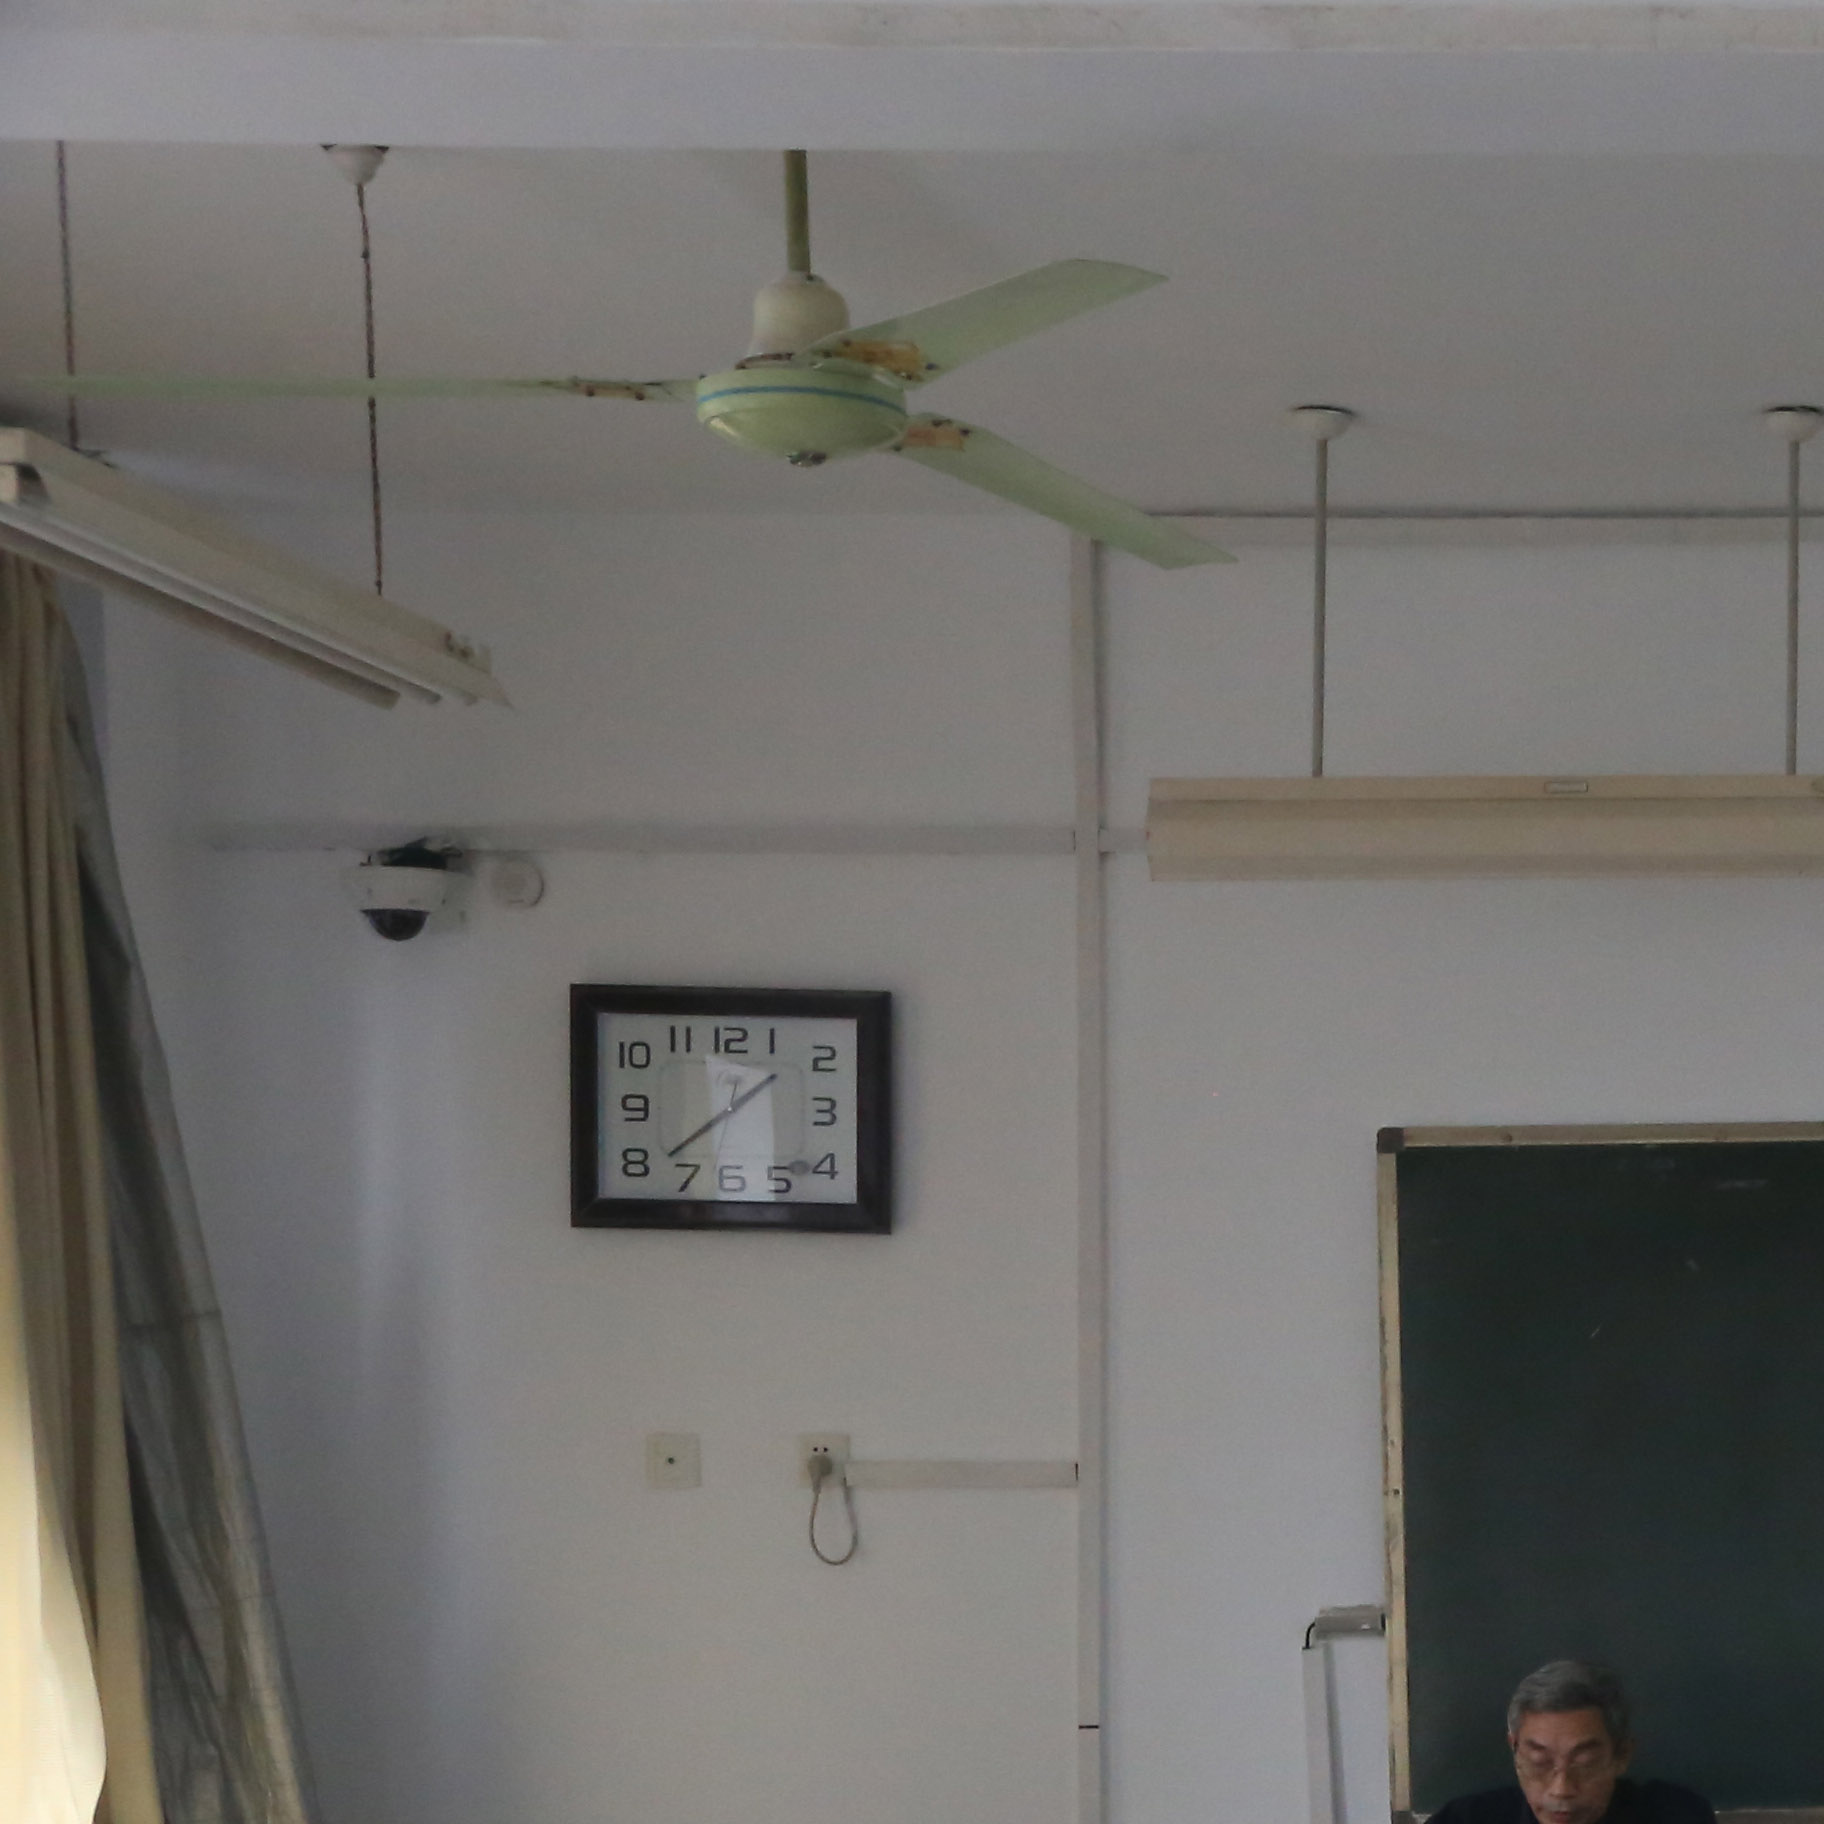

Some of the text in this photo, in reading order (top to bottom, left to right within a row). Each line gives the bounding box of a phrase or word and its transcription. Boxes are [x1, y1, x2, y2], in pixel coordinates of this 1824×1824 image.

[670, 1025, 691, 1053] 11
[714, 1026, 748, 1054] 12
[619, 1041, 650, 1069] 10
[812, 1046, 836, 1072] 2
[621, 1094, 649, 1122] 9
[812, 1097, 837, 1126] 3
[622, 1148, 649, 1177] 8
[812, 1152, 838, 1180] 4
[675, 1163, 700, 1192] 7
[718, 1165, 746, 1192] 6
[768, 1166, 792, 1193] 5
